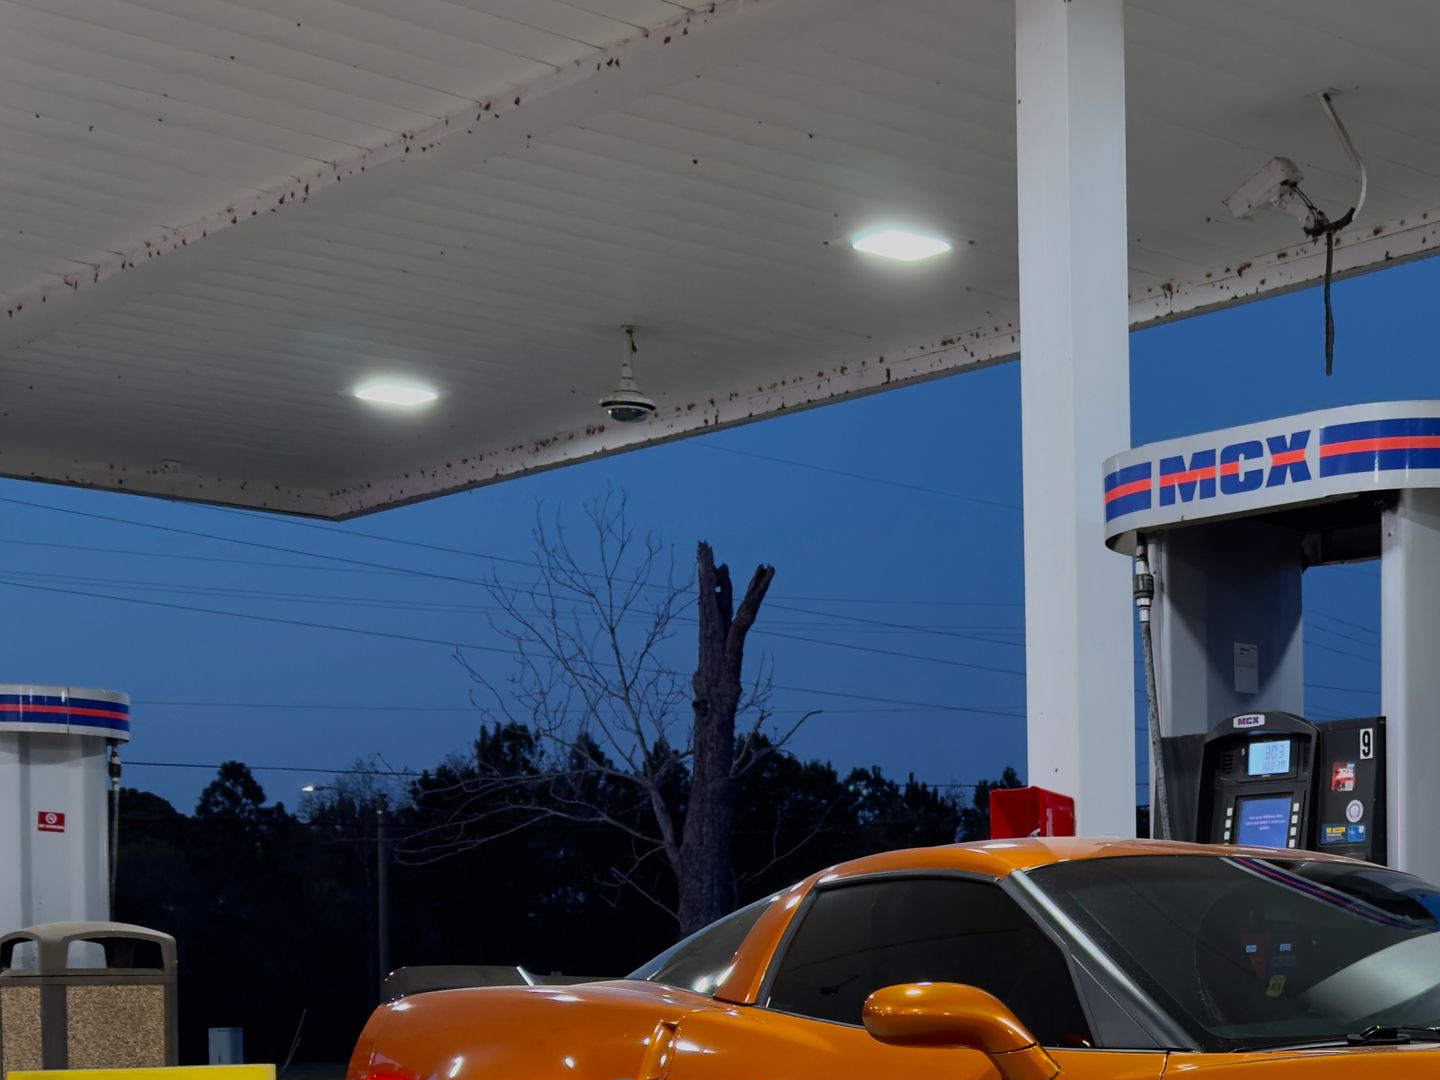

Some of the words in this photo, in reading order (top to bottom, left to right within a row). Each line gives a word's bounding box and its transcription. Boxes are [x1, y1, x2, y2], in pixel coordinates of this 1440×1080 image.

[1159, 430, 1312, 507] MCX
[1238, 716, 1259, 725] MCX
[1362, 730, 1371, 757] 9
